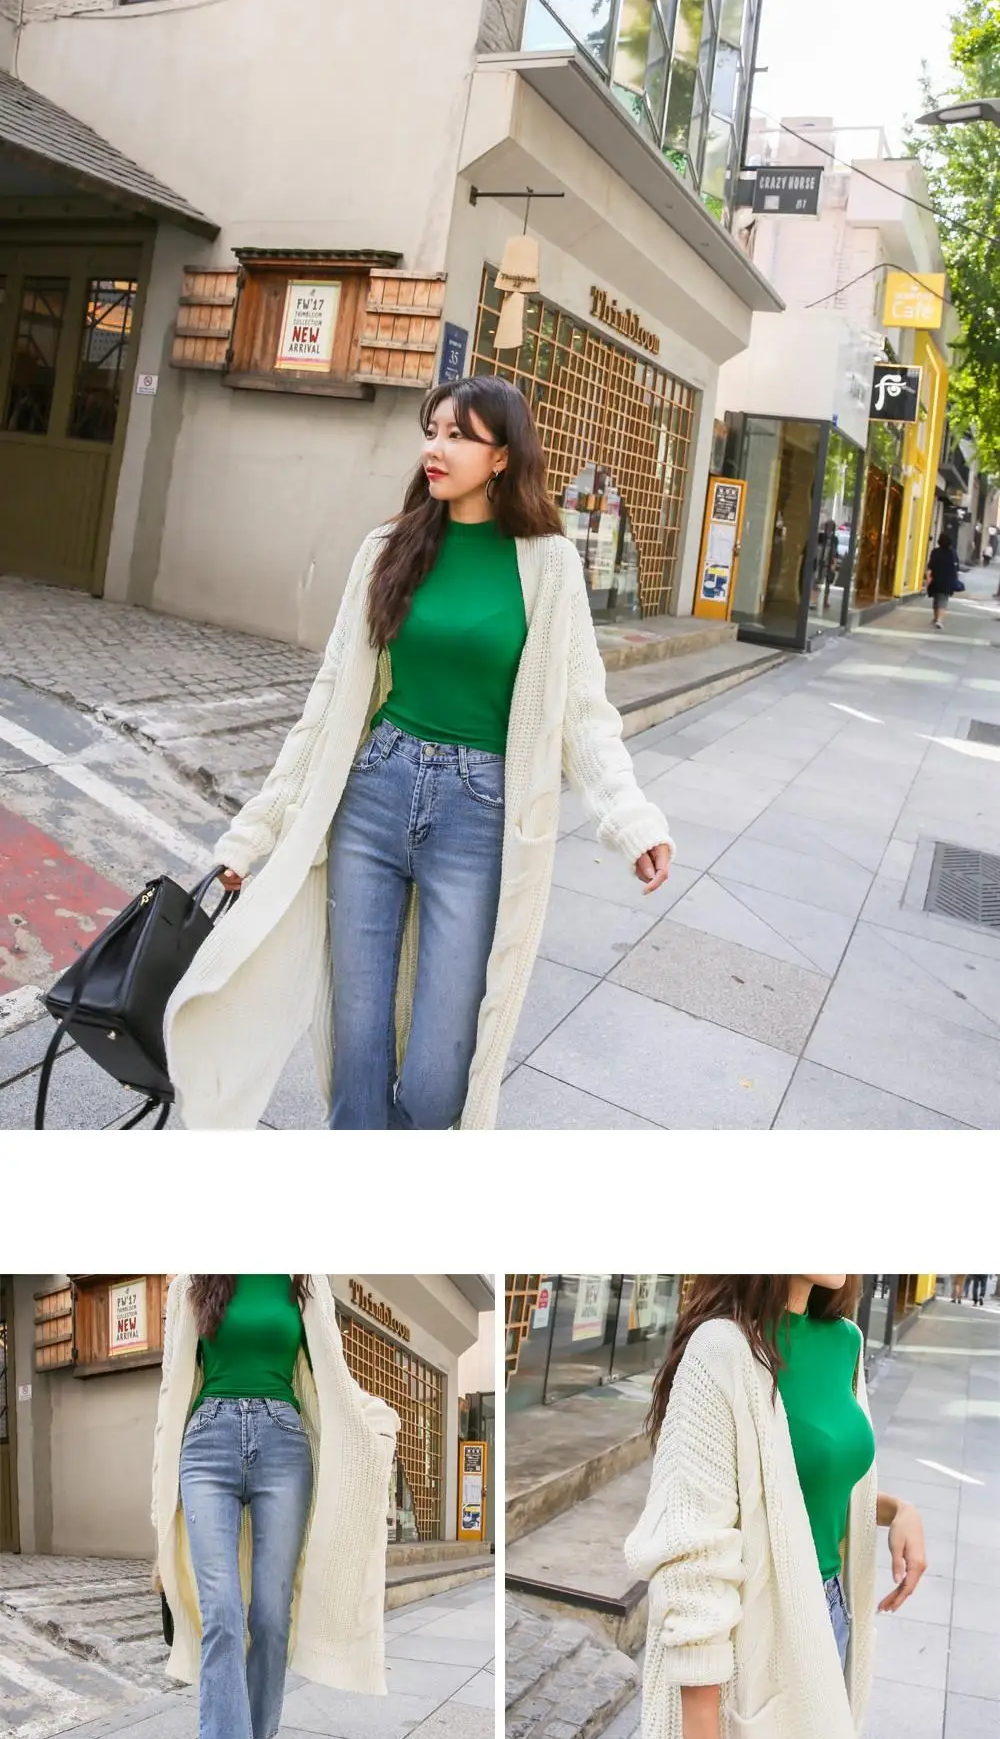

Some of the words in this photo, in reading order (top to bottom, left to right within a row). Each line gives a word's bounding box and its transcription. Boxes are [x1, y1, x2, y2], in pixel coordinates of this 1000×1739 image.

[759, 176, 788, 190] CRAZY
[788, 176, 815, 190] HORSE
[292, 325, 320, 343] NEW
[288, 343, 320, 354] ARRIVAL
[117, 1317, 137, 1333] NEW
[116, 1331, 139, 1342] ARRIVAL
